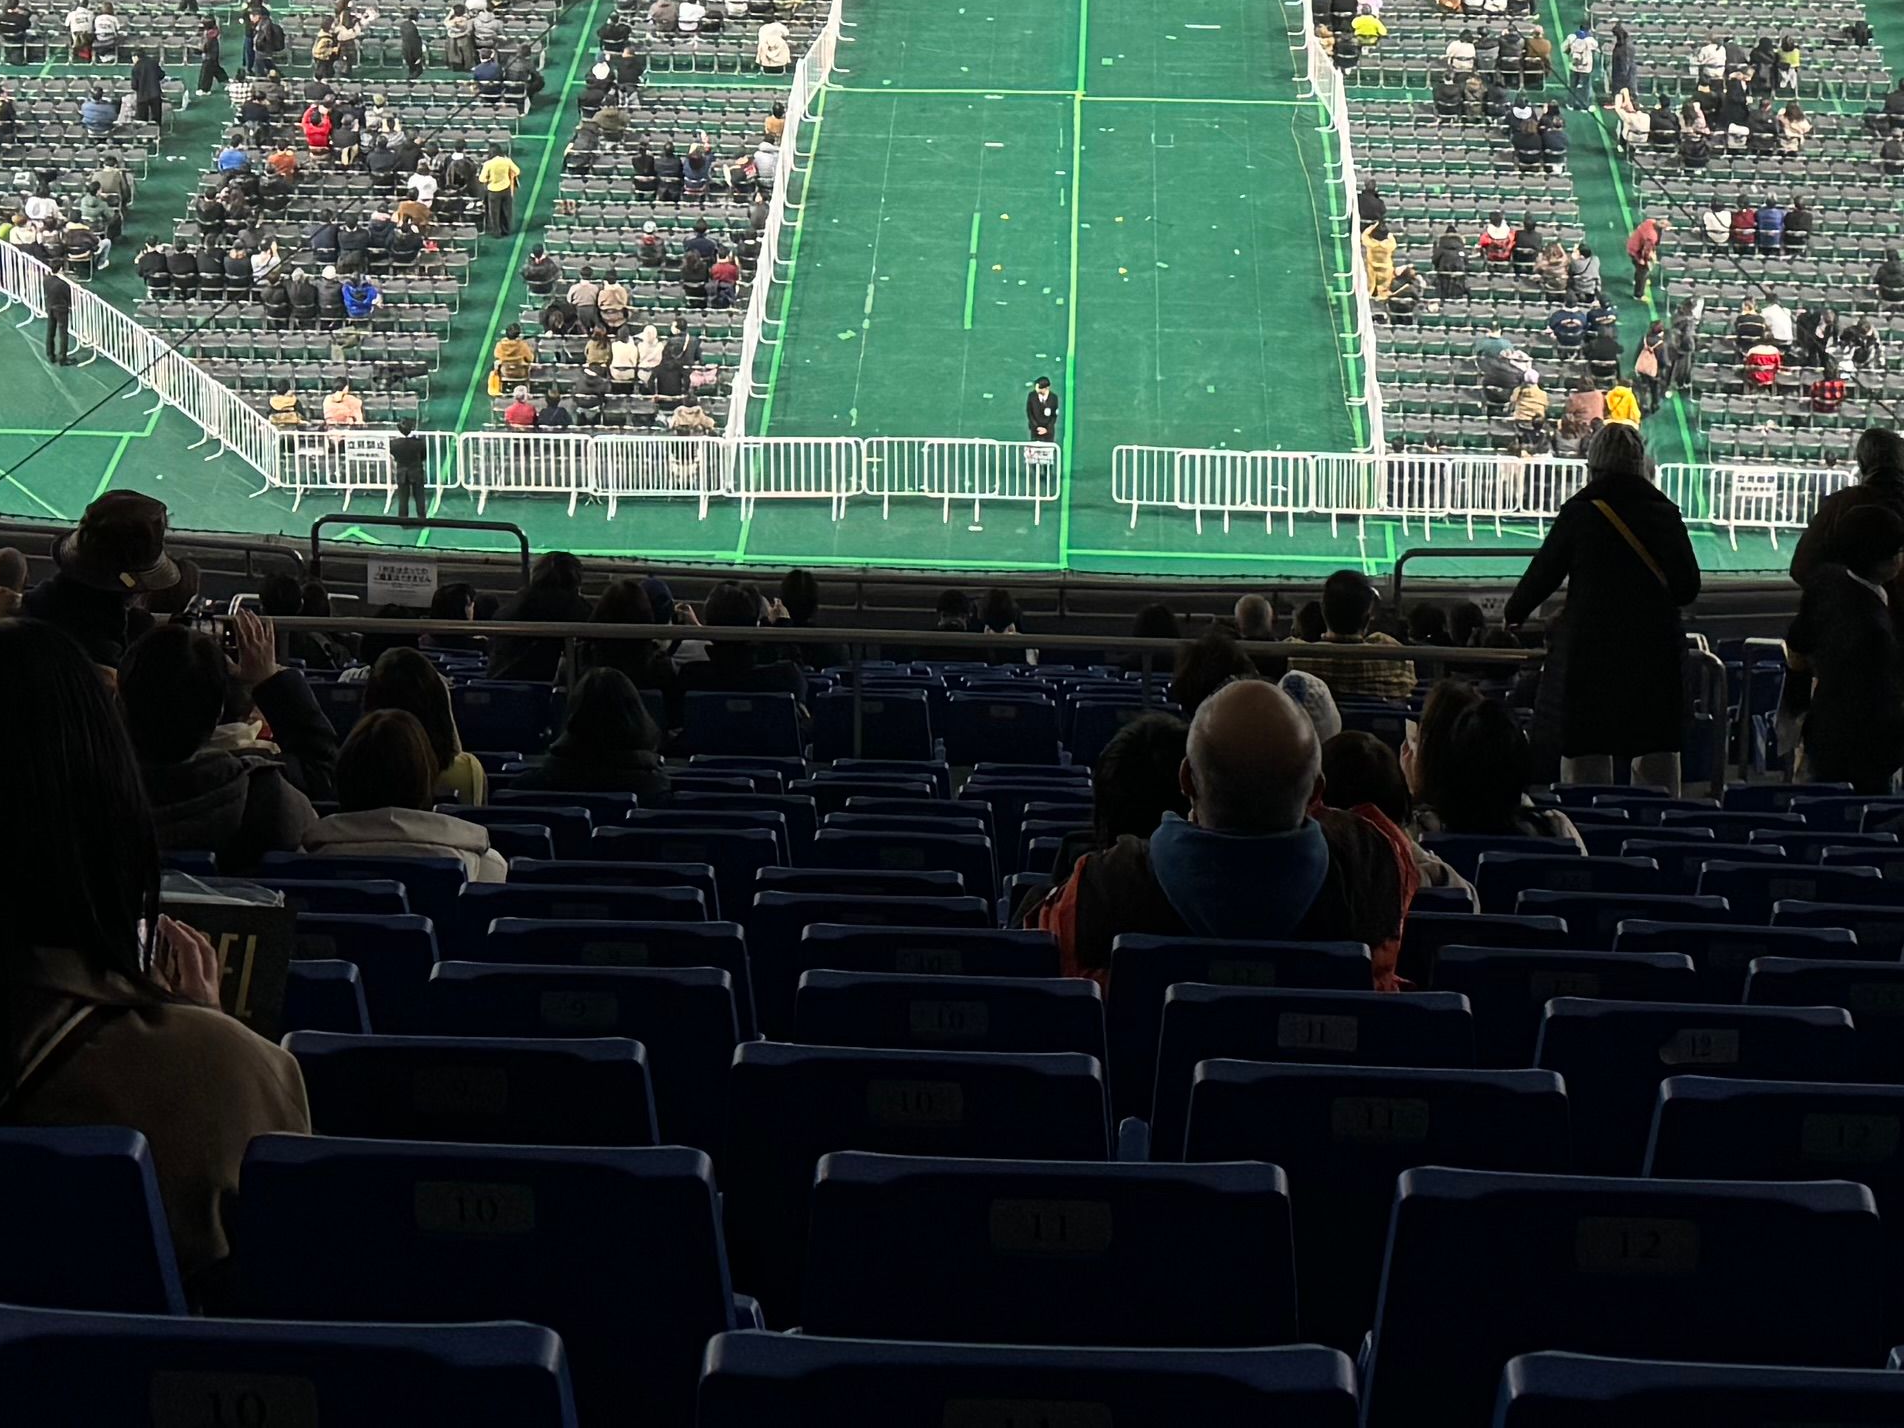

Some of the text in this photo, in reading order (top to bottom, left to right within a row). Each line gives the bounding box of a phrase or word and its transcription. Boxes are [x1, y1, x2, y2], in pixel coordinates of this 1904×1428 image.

[456, 1196, 498, 1223] 10
[1034, 1214, 1067, 1242] 11
[1621, 1230, 1662, 1259] 12
